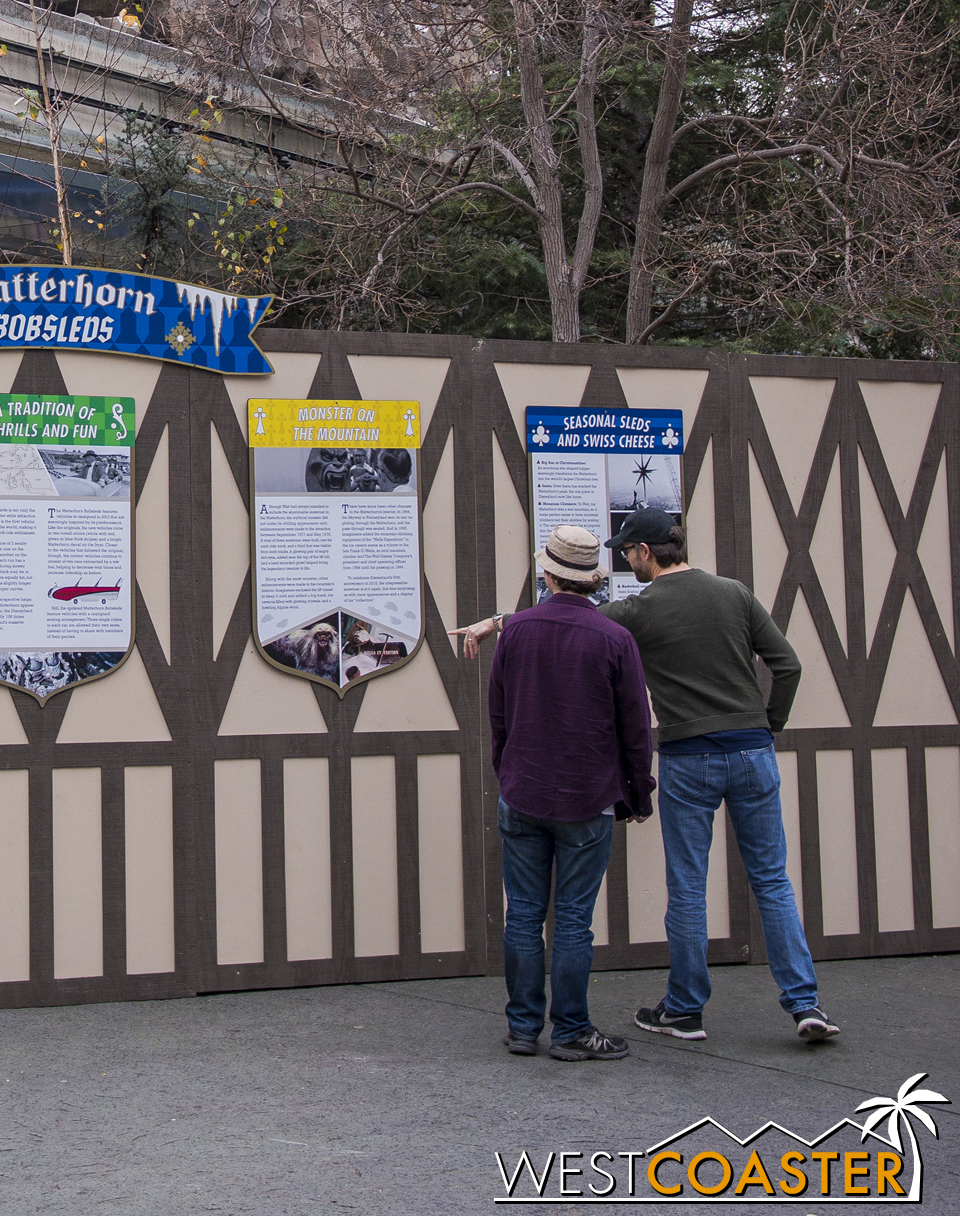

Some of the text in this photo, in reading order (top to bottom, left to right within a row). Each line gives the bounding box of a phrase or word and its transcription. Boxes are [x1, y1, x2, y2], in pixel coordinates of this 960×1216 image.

[8, 401, 75, 417] TRADITION
[78, 405, 96, 421] OF
[298, 406, 376, 423] MONSTER ON
[42, 423, 69, 438] AND
[73, 424, 98, 439] FUN
[563, 414, 651, 432] SEASONAL SLEDS
[293, 427, 380, 442] THE MOUNTAIN
[557, 433, 655, 449] AND SWISS CHEESE
